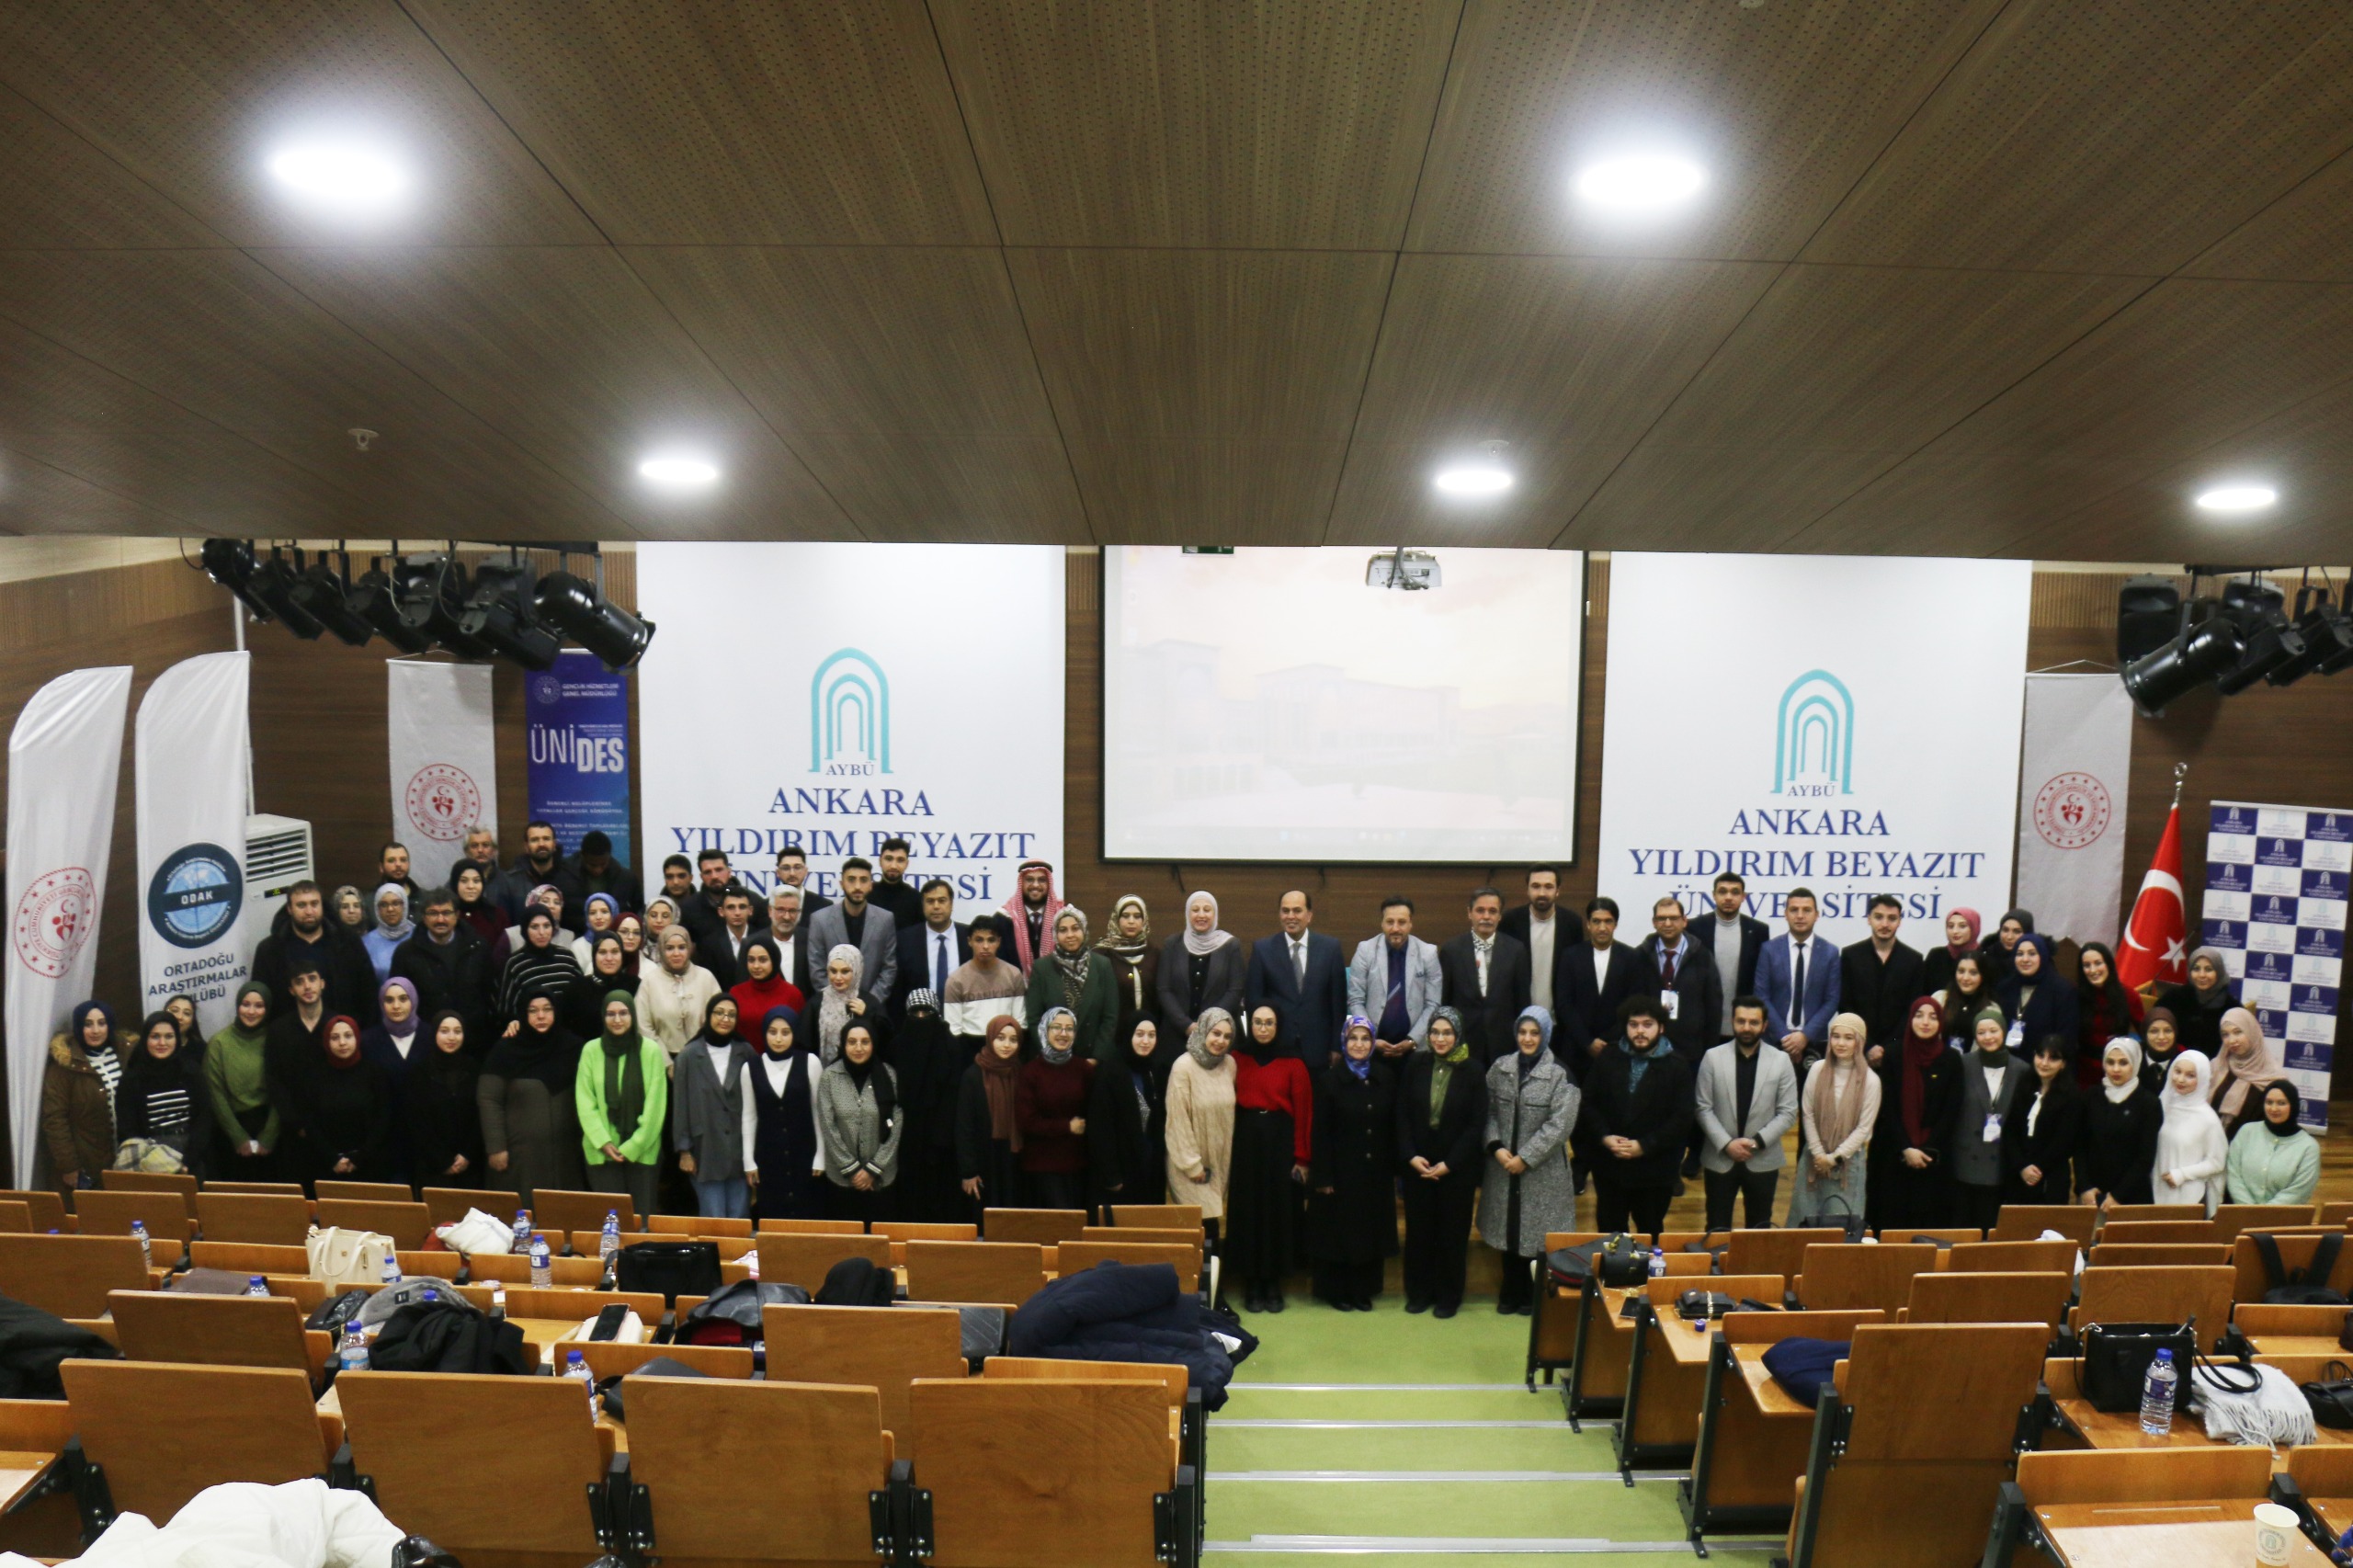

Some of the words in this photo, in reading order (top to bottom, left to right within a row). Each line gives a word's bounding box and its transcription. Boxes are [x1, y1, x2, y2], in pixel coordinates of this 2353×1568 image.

[825, 760, 875, 777] AYBÜ
[768, 787, 935, 816] ANKARA
[1787, 782, 1836, 797] AYBÜ
[1728, 808, 1891, 836] ANKARA
[671, 827, 858, 857] YILDIRIM
[1629, 848, 1815, 877] YILDIRIM
[1824, 850, 1985, 879] BEYAZIT
[164, 952, 234, 977] ORTADOĞU
[148, 965, 247, 996] ARAŞTIRMALAR
